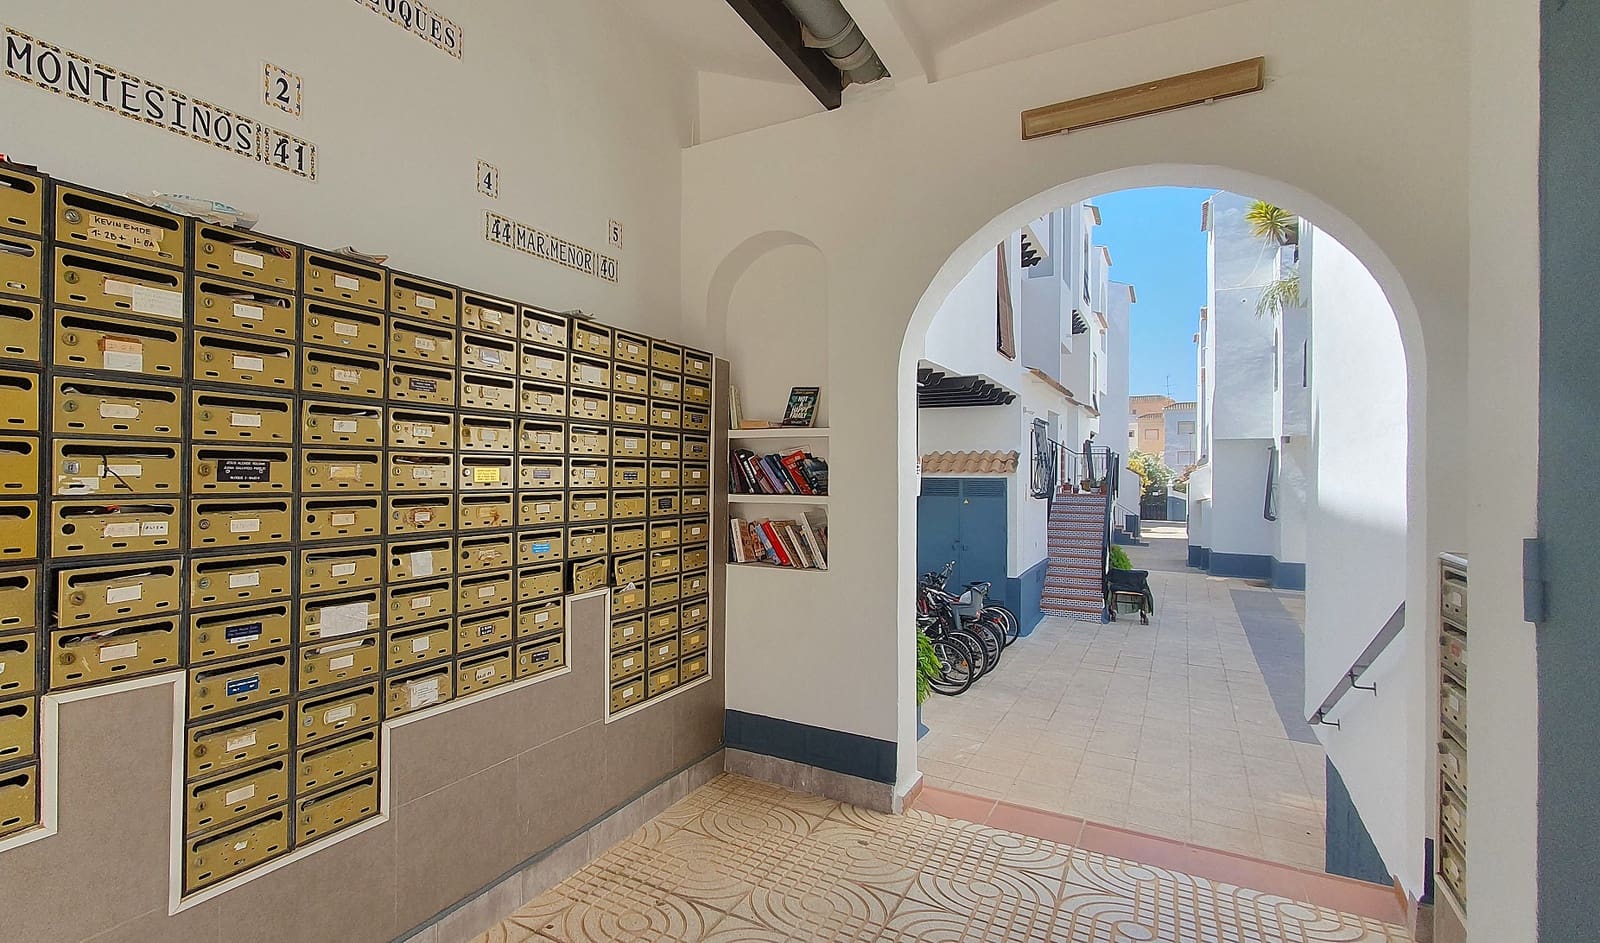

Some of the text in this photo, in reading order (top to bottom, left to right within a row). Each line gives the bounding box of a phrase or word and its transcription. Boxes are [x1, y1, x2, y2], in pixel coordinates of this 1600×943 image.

[354, 0, 455, 48] OQUES
[6, 35, 305, 171] MONTESINOS 41
[275, 77, 291, 104] 2
[483, 171, 493, 190] 4
[94, 215, 122, 228] KEVIN
[612, 227, 619, 242] 5
[491, 219, 512, 243] 44
[600, 259, 615, 279] 40
